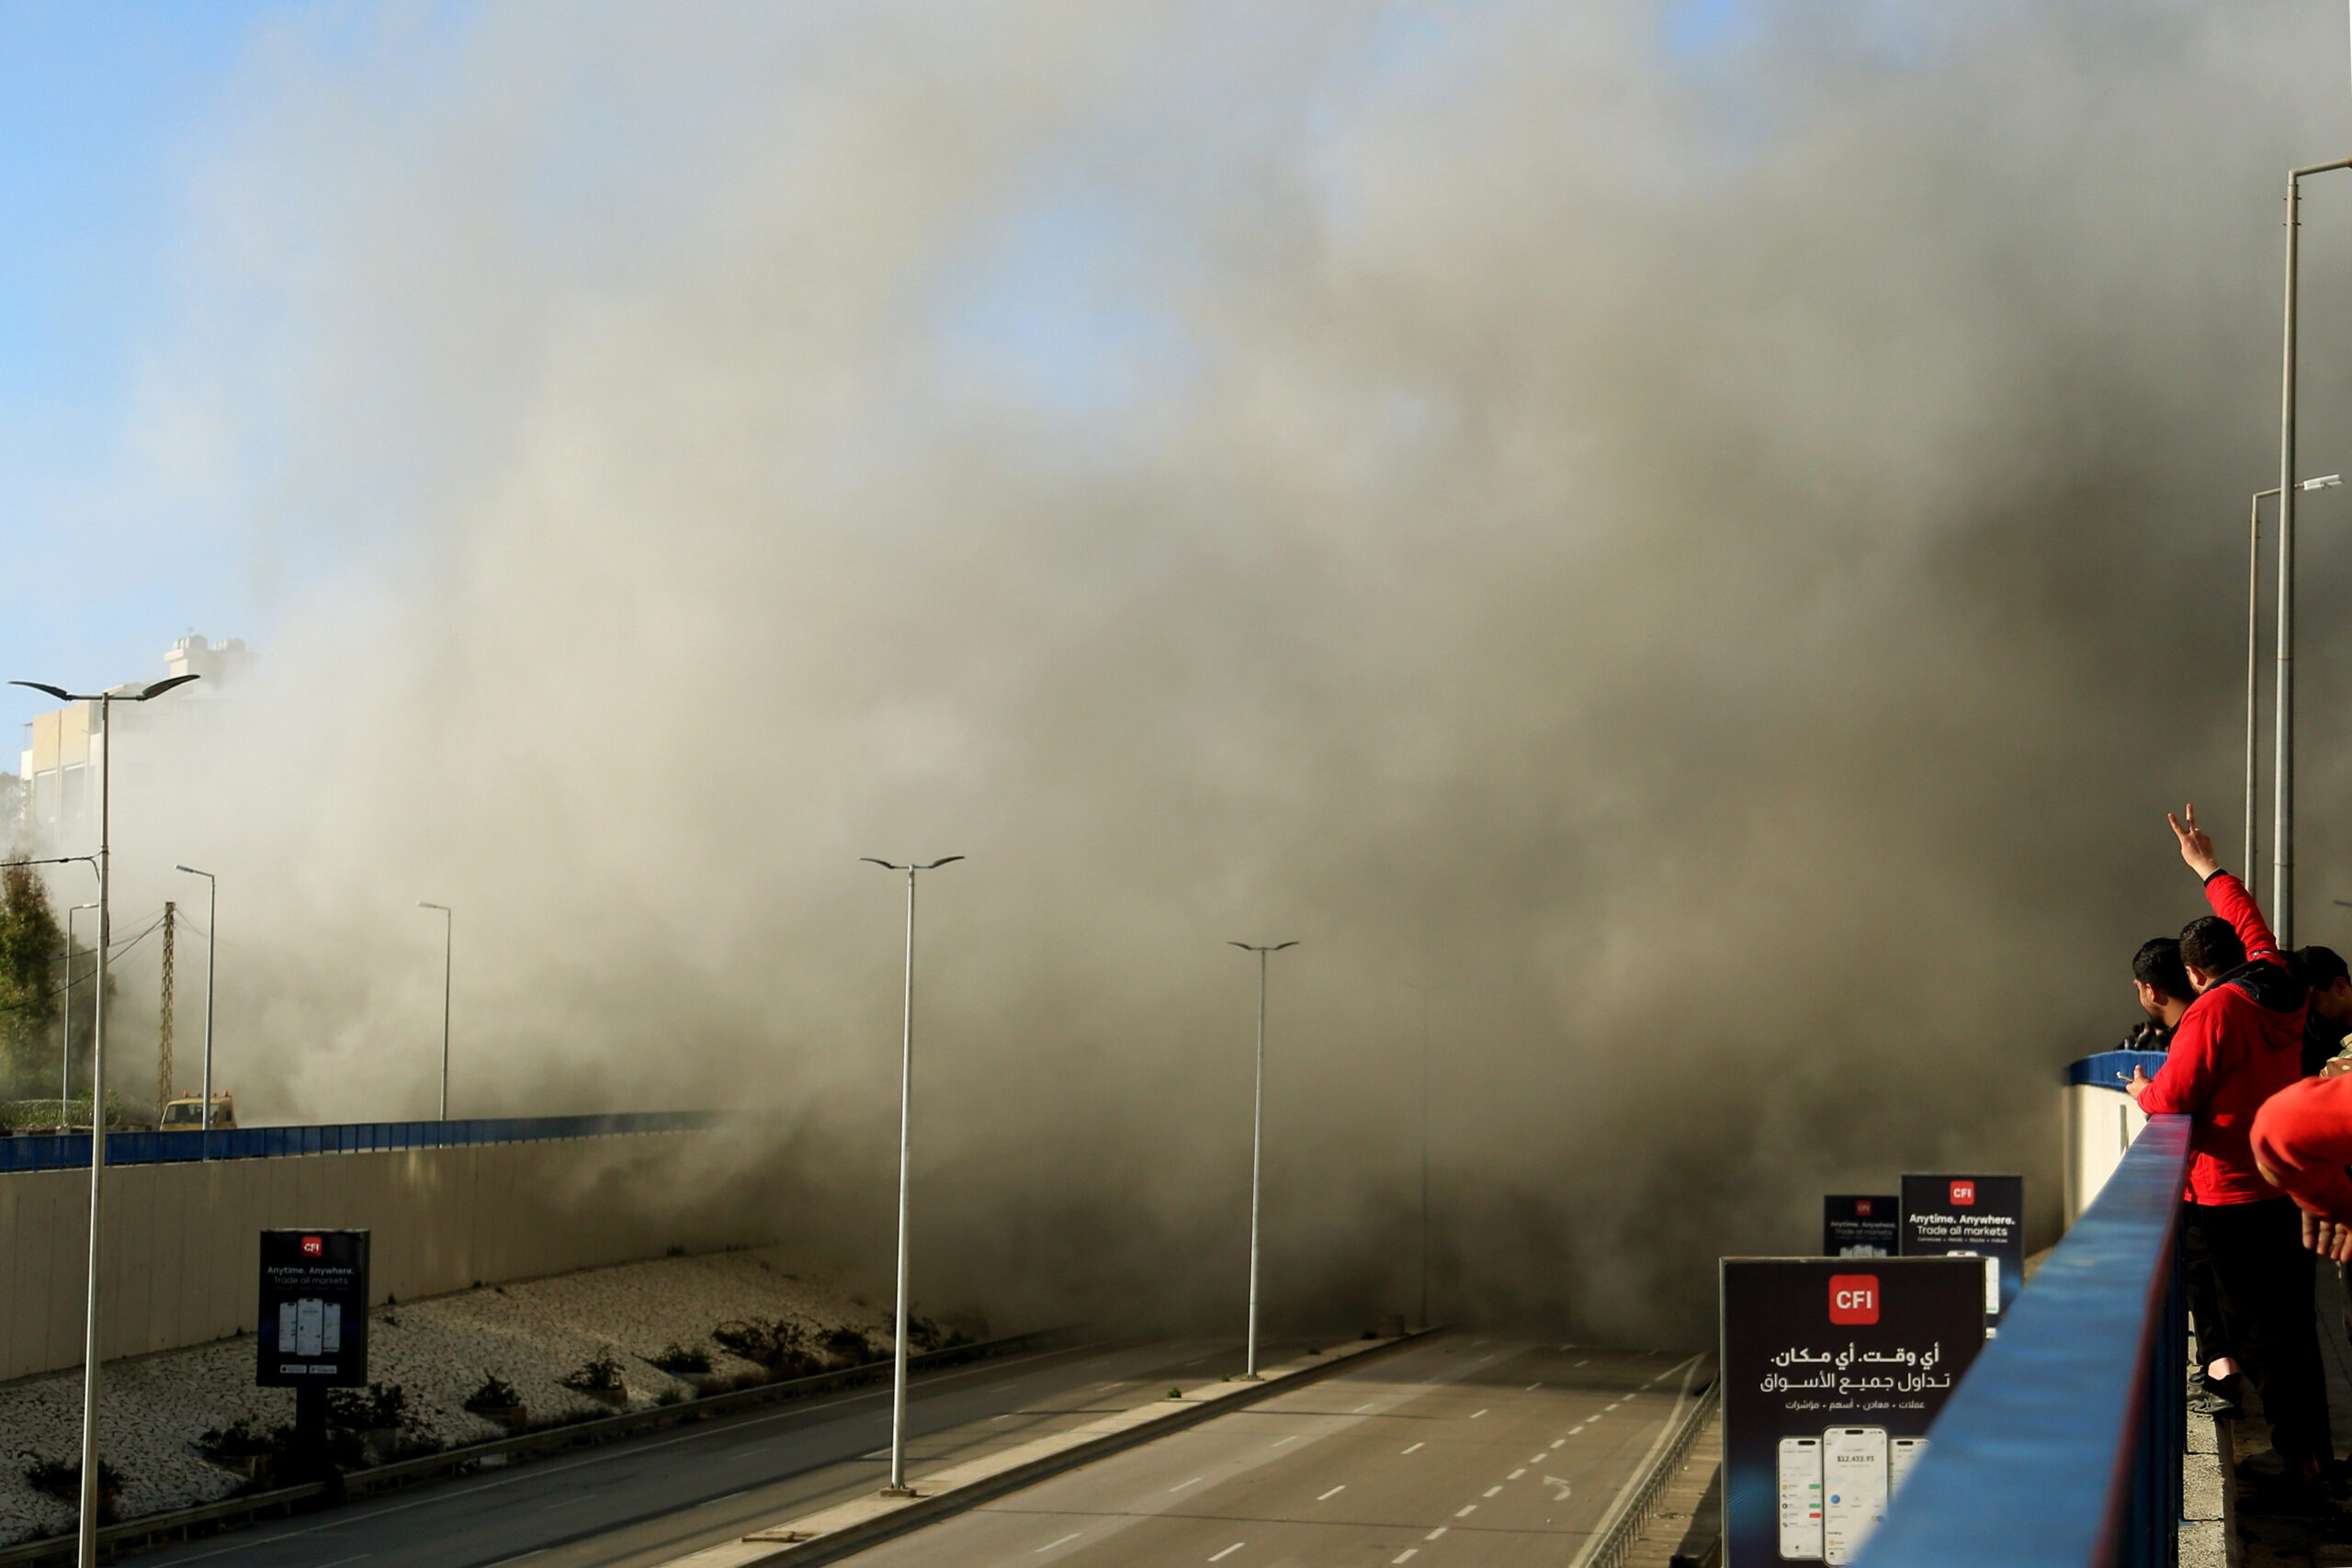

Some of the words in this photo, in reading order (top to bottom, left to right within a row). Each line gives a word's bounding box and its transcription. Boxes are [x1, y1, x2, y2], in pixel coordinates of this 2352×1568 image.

[1953, 1188, 1972, 1198] CFI
[1909, 1213, 1957, 1225] Anytime.
[1959, 1214, 2016, 1226] Anywhere.
[1917, 1225, 1948, 1235] Trade
[1949, 1225, 1962, 1235] all
[1963, 1225, 2008, 1236] markets
[303, 1243, 319, 1251] CFI
[267, 1266, 307, 1276] Anytime.
[309, 1266, 355, 1276] Anywhere.
[274, 1276, 299, 1284] Trade
[300, 1276, 311, 1284] all
[311, 1276, 348, 1285] markets
[1836, 1291, 1872, 1309] CFI
[1770, 1348, 1831, 1367] مكان.
[1835, 1342, 1855, 1371] أي
[1858, 1348, 1917, 1367] وقت.
[1919, 1342, 1939, 1371] أي
[1759, 1371, 1835, 1393] الأسواق
[1838, 1375, 1894, 1394] جميع
[1897, 1372, 1951, 1393] تداول
[1785, 1400, 1820, 1411] مؤشرات
[1828, 1399, 1854, 1411] أسهم
[1862, 1400, 1889, 1411] معادن
[1898, 1400, 1925, 1409] عملات
